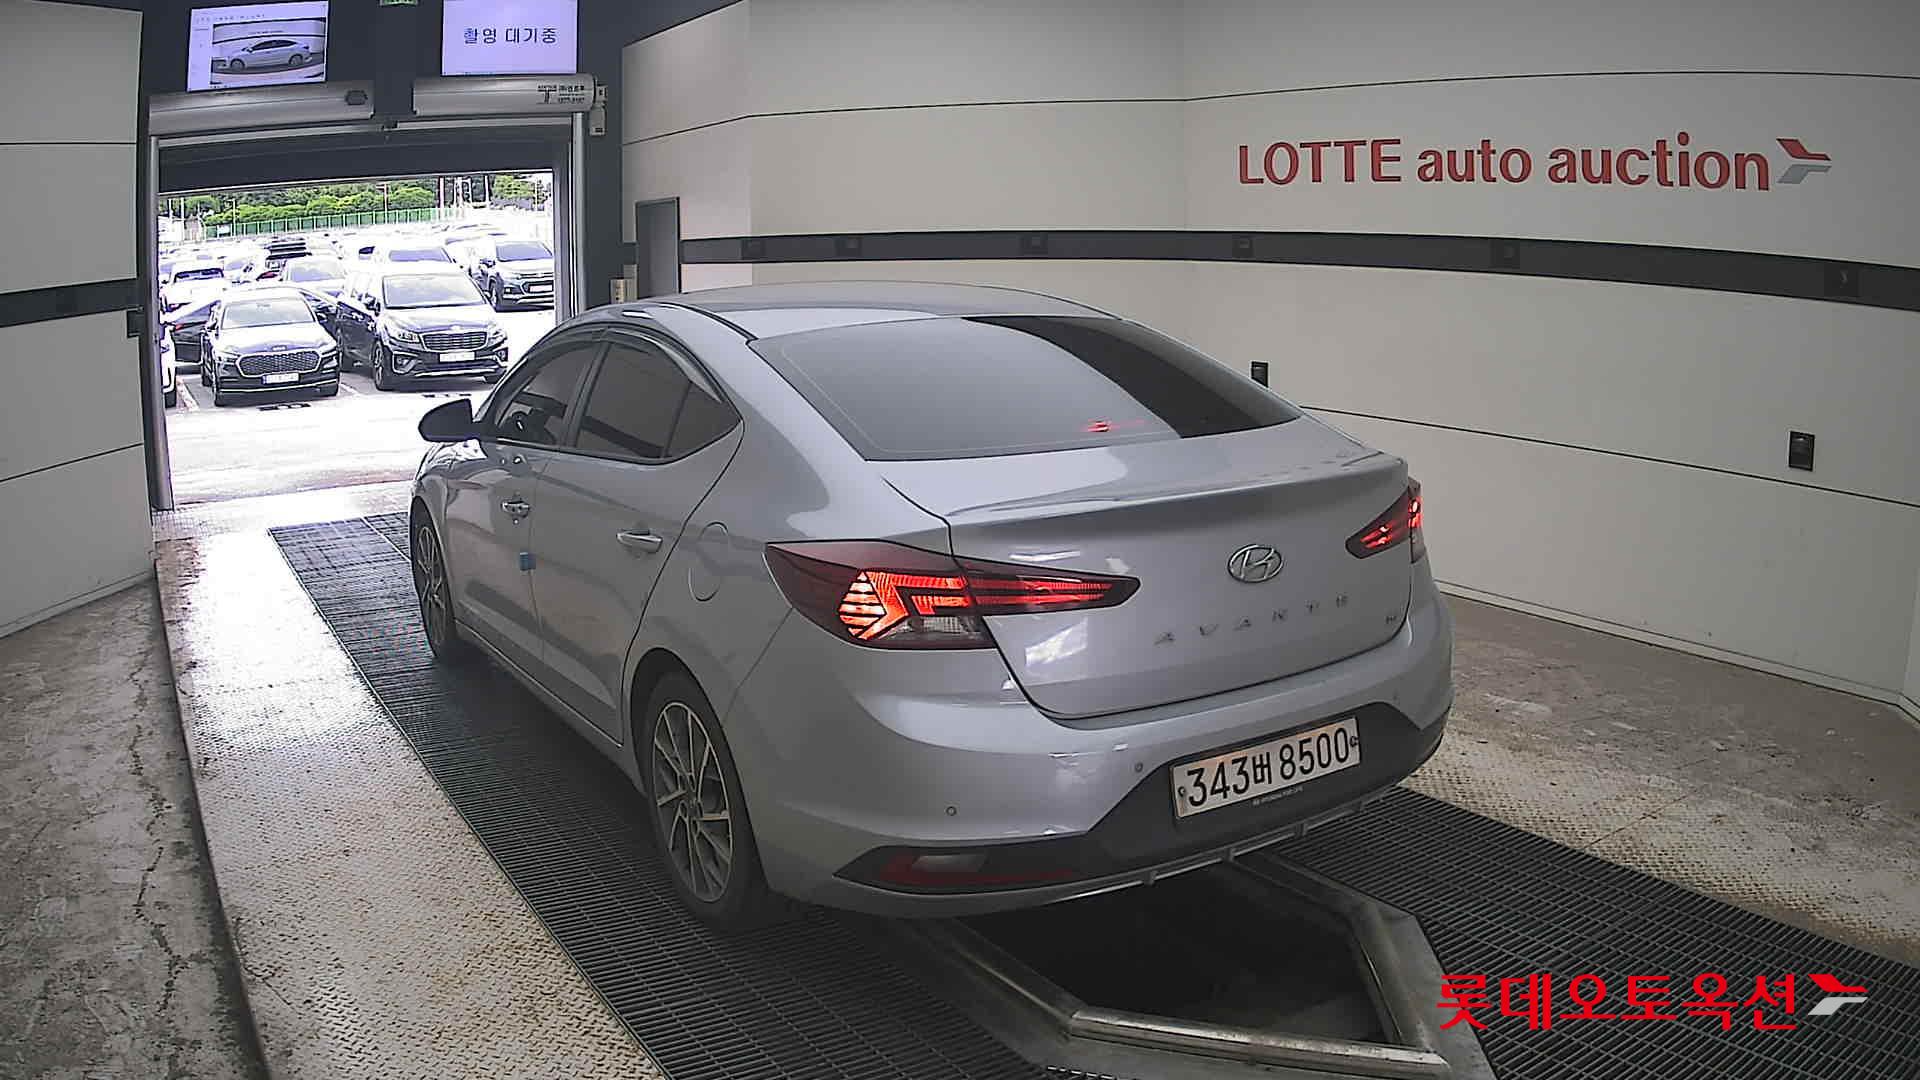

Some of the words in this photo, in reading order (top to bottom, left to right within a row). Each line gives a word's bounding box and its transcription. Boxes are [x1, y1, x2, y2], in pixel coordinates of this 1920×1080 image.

[505, 27, 558, 44] 대기중
[1238, 138, 1401, 185] LOTTE
[1417, 139, 1533, 185] auto
[1547, 131, 1770, 191] auction
[1279, 727, 1350, 781] 8500
